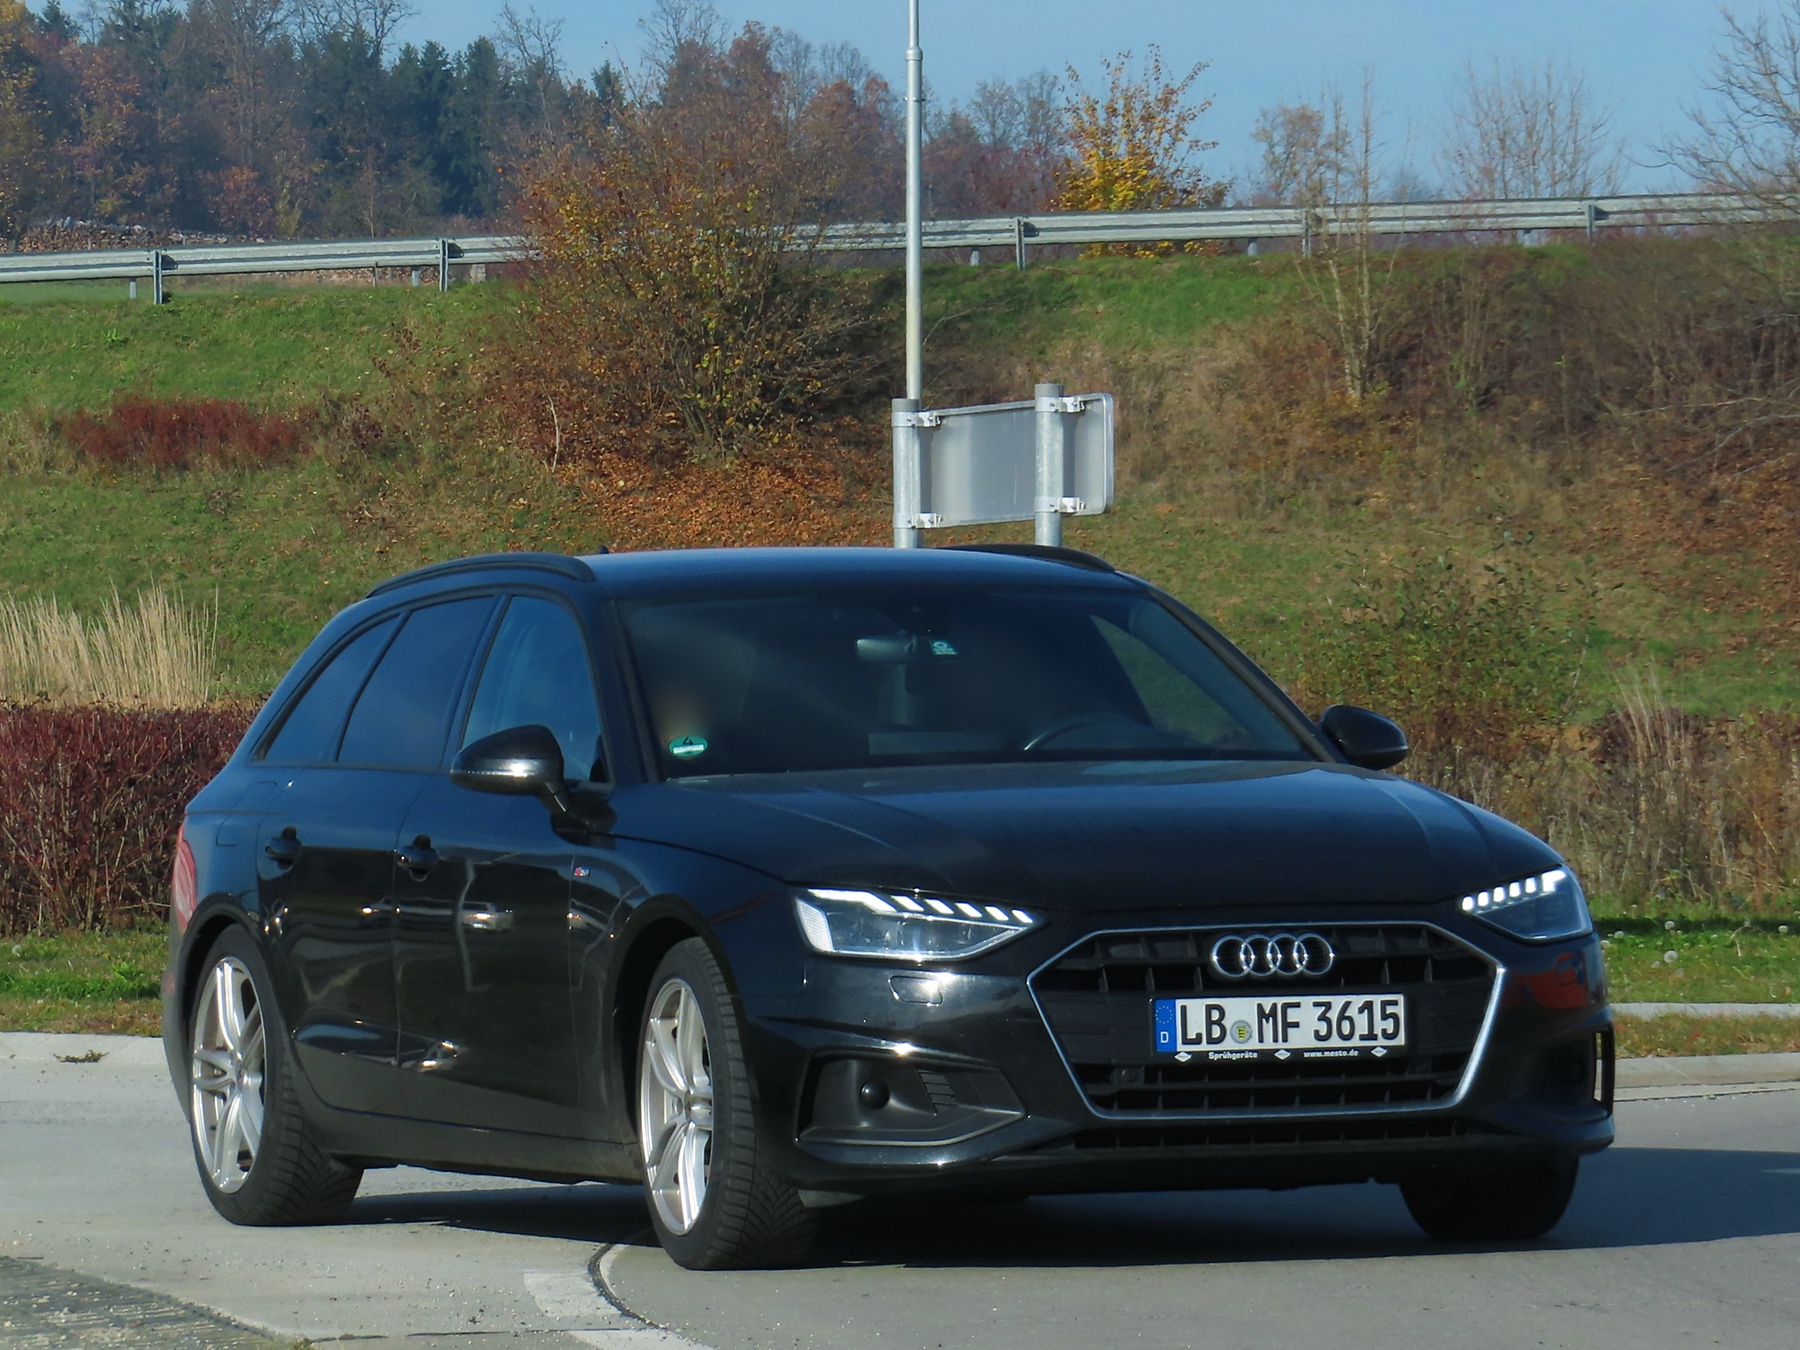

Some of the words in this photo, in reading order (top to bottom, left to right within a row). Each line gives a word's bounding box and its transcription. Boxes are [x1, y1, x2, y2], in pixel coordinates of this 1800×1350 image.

[1179, 1003, 1227, 1045] LB
[1256, 1001, 1301, 1043] MF
[1312, 1000, 1401, 1042] 3615
[1160, 1031, 1169, 1044] D
[1208, 1051, 1258, 1060] Sprühgeräte
[1303, 1049, 1359, 1058] www.mesto.de
